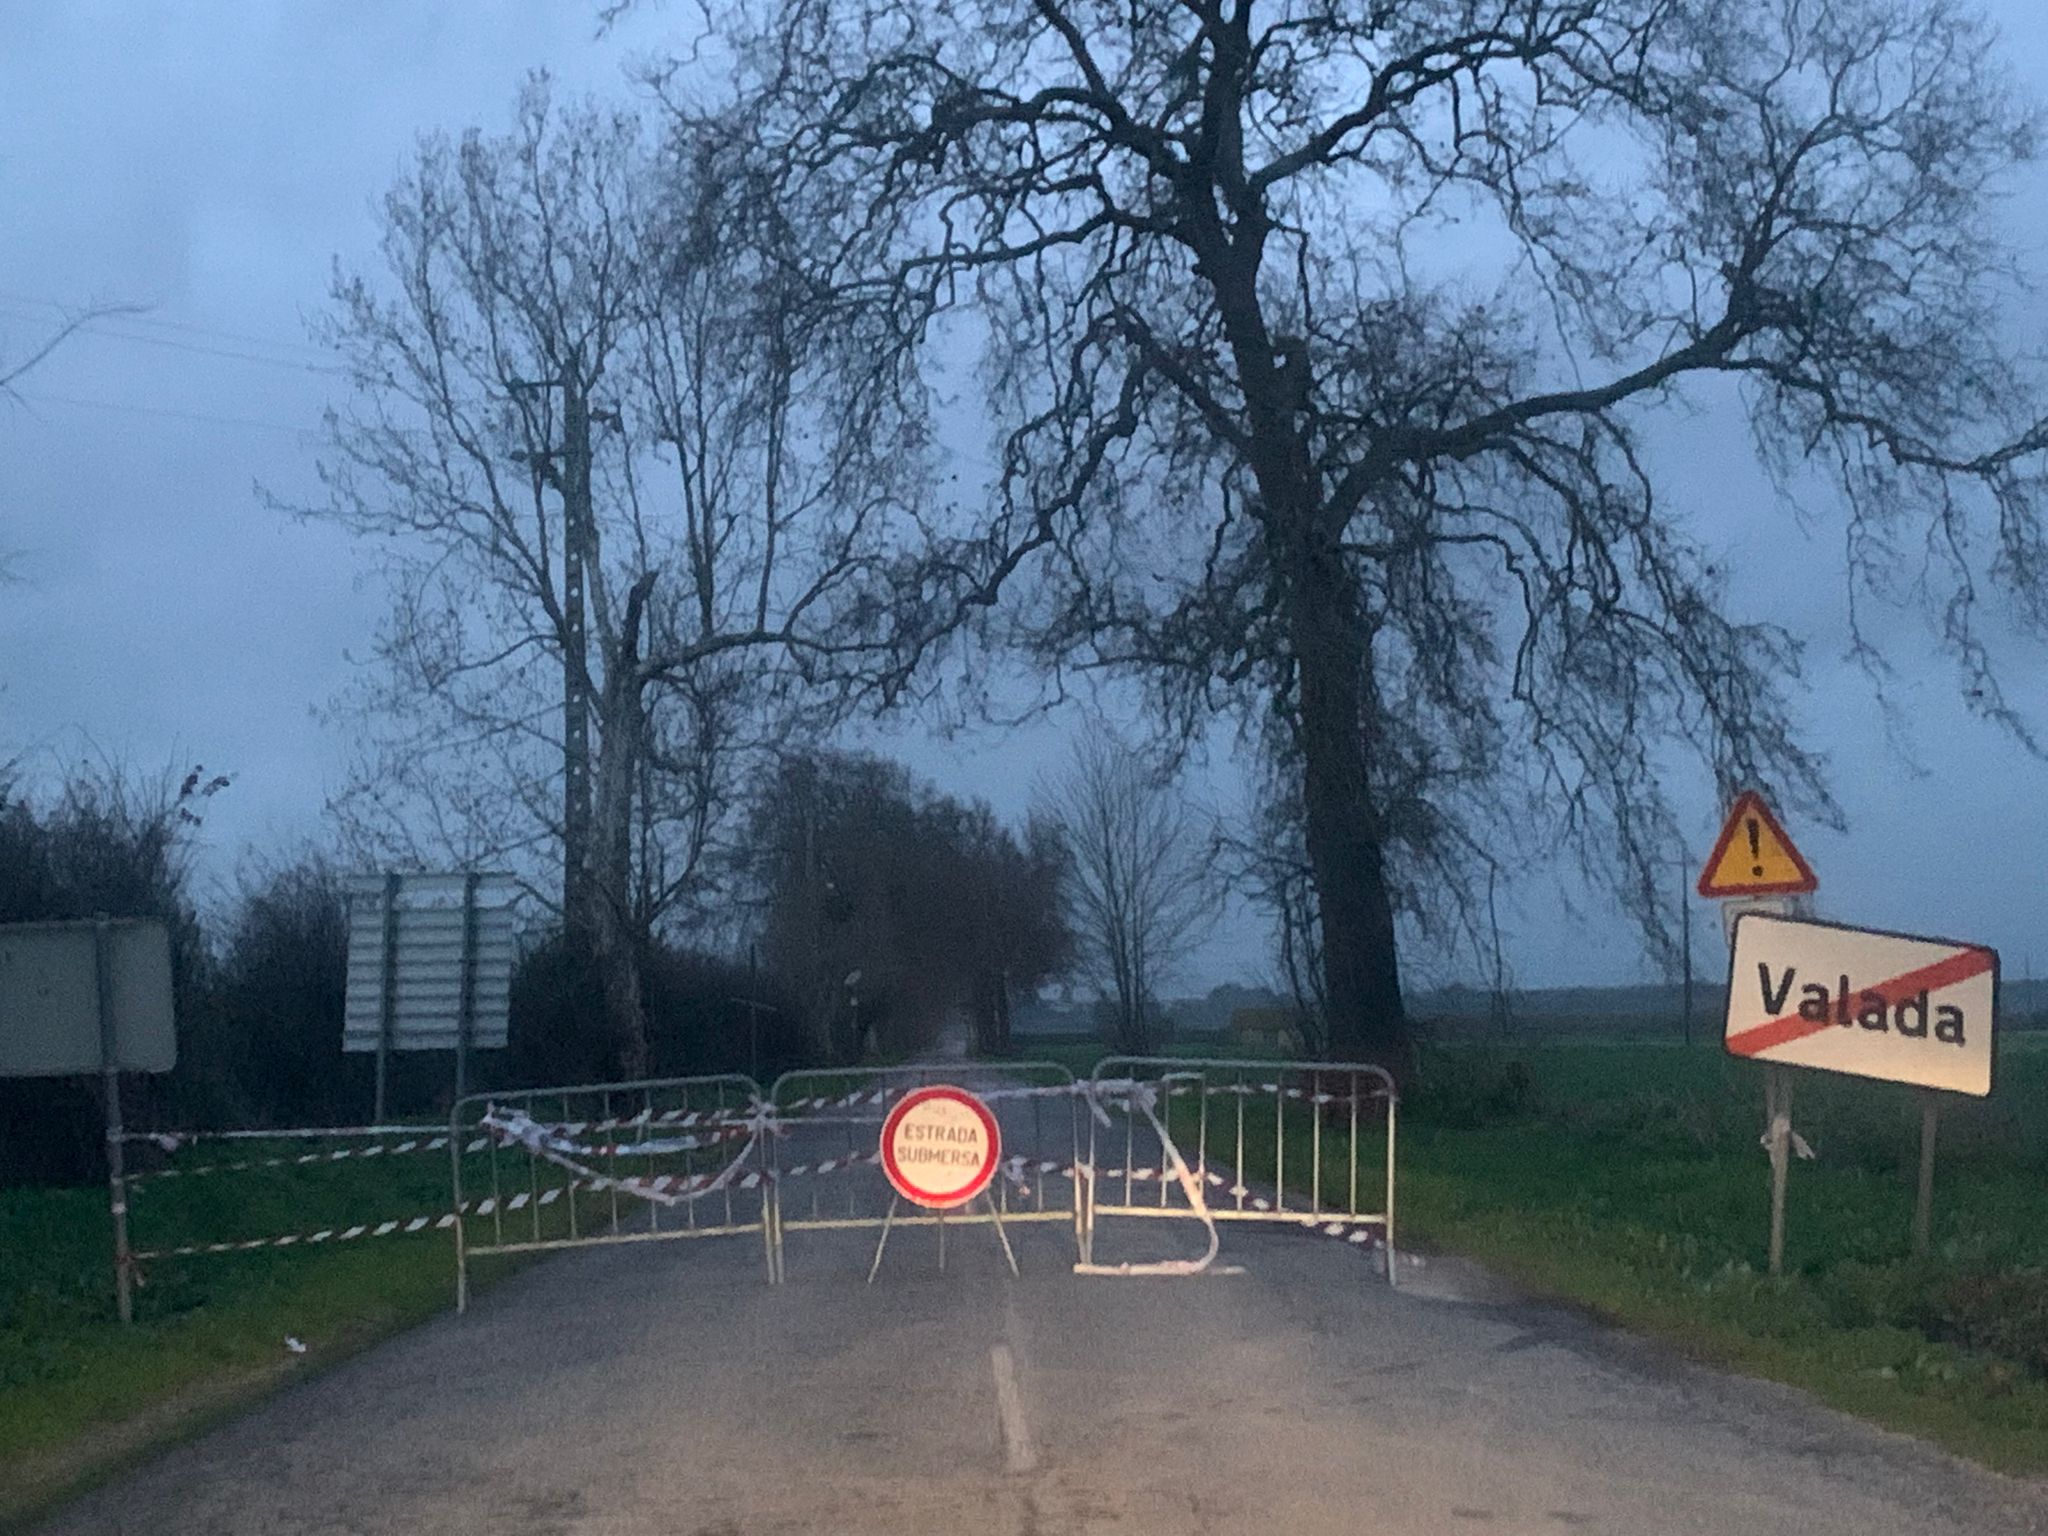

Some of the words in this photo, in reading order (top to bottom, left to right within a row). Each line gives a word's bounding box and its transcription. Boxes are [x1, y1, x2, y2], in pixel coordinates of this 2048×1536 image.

[1758, 962, 1966, 1047] Valada
[904, 1123, 978, 1144] ESTRADA
[897, 1146, 980, 1167] SUBMERSA
